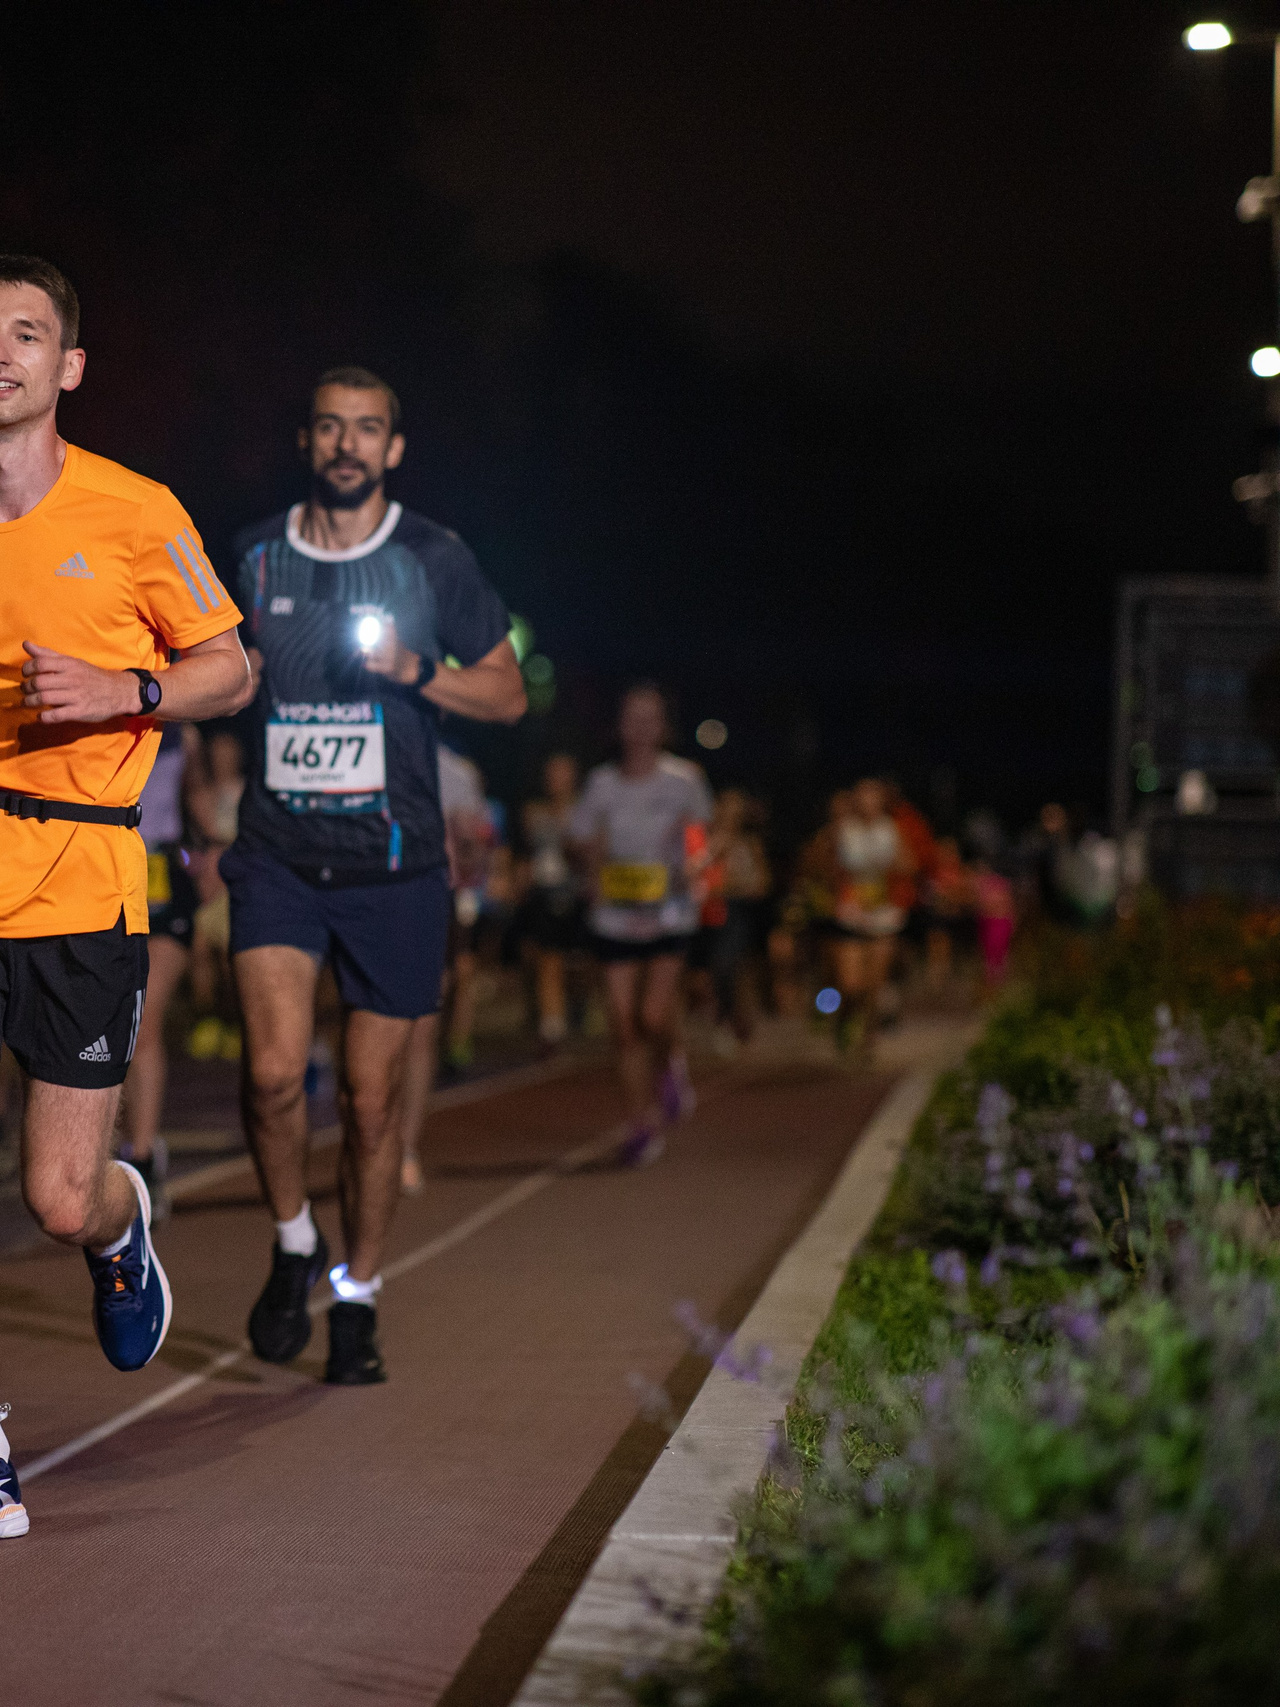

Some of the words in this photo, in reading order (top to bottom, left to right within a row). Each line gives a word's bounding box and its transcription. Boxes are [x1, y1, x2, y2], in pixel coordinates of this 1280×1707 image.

[54, 567, 95, 579] adidas
[281, 736, 367, 769] 4677
[78, 1051, 112, 1062] adidas
